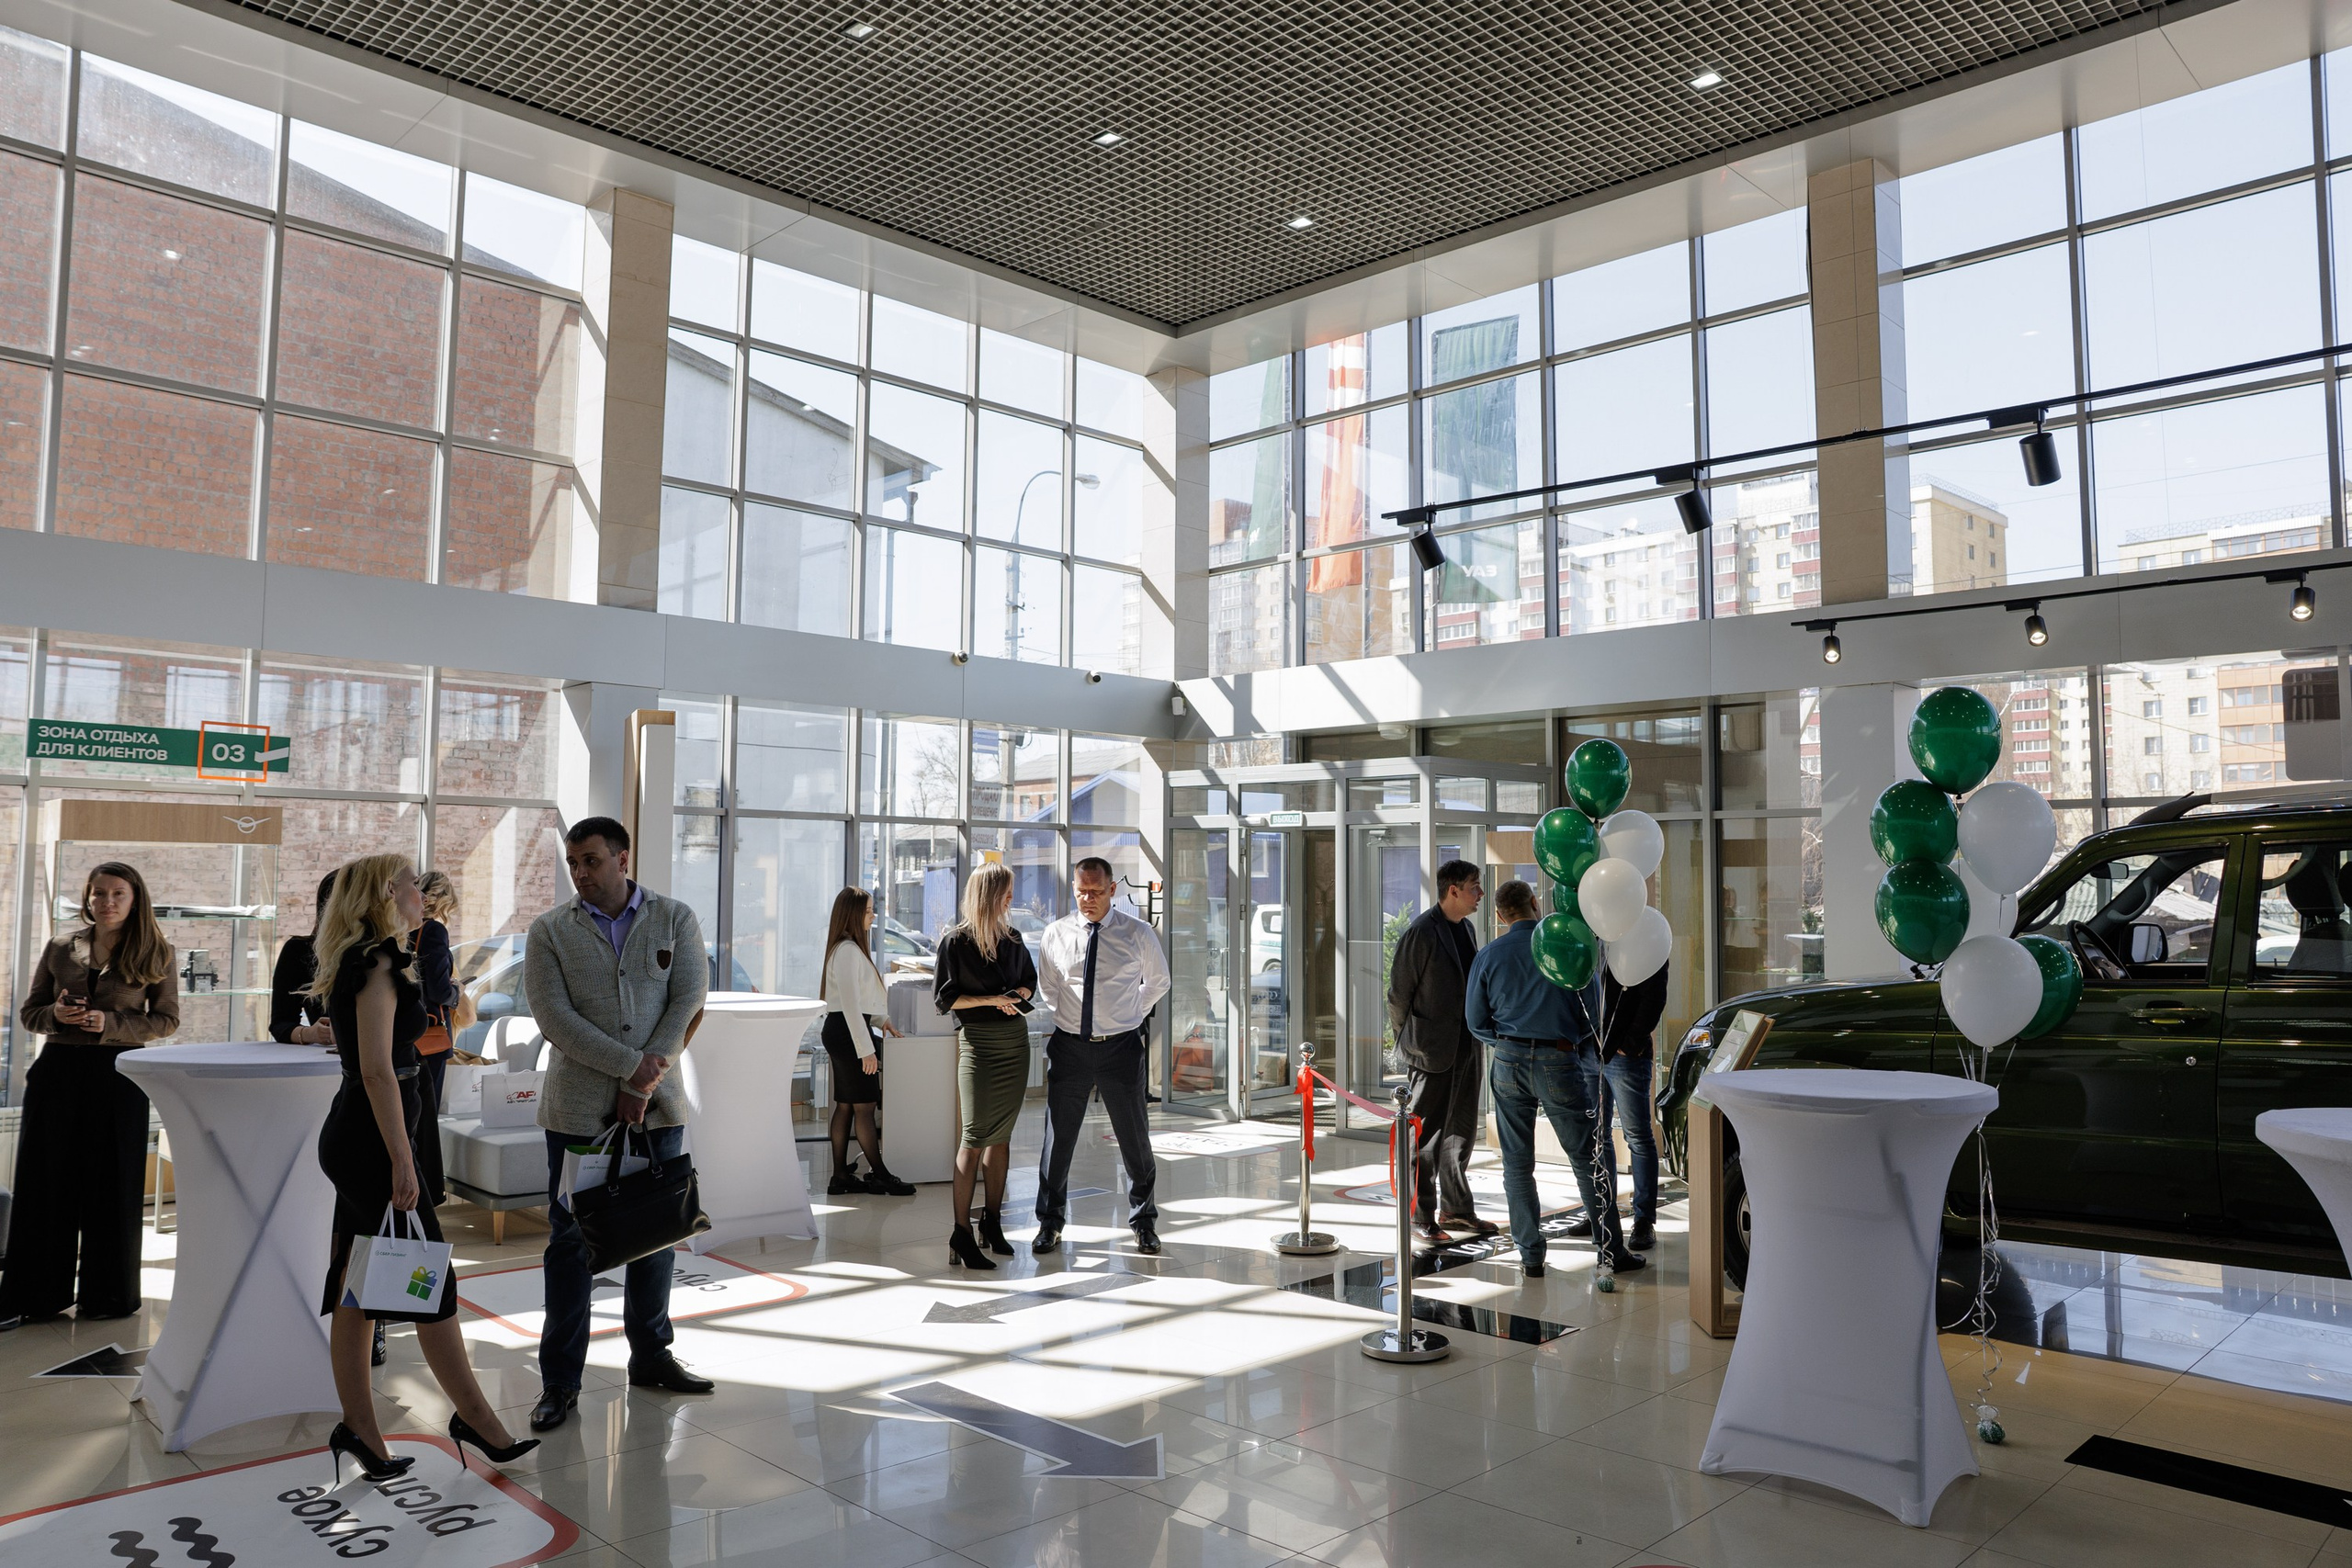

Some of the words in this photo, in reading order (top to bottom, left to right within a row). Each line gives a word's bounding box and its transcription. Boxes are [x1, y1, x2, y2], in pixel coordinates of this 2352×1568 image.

[1462, 565, 1498, 578] УАЗ
[37, 725, 87, 740] ЗОНА
[90, 728, 160, 745] ОТДЫХА
[36, 741, 74, 756] ДЛЯ
[78, 745, 168, 761] КЛИЕНТОВ
[211, 743, 245, 762] 03
[1272, 814, 1300, 823] ВЫХОД
[277, 1485, 395, 1559] сухое
